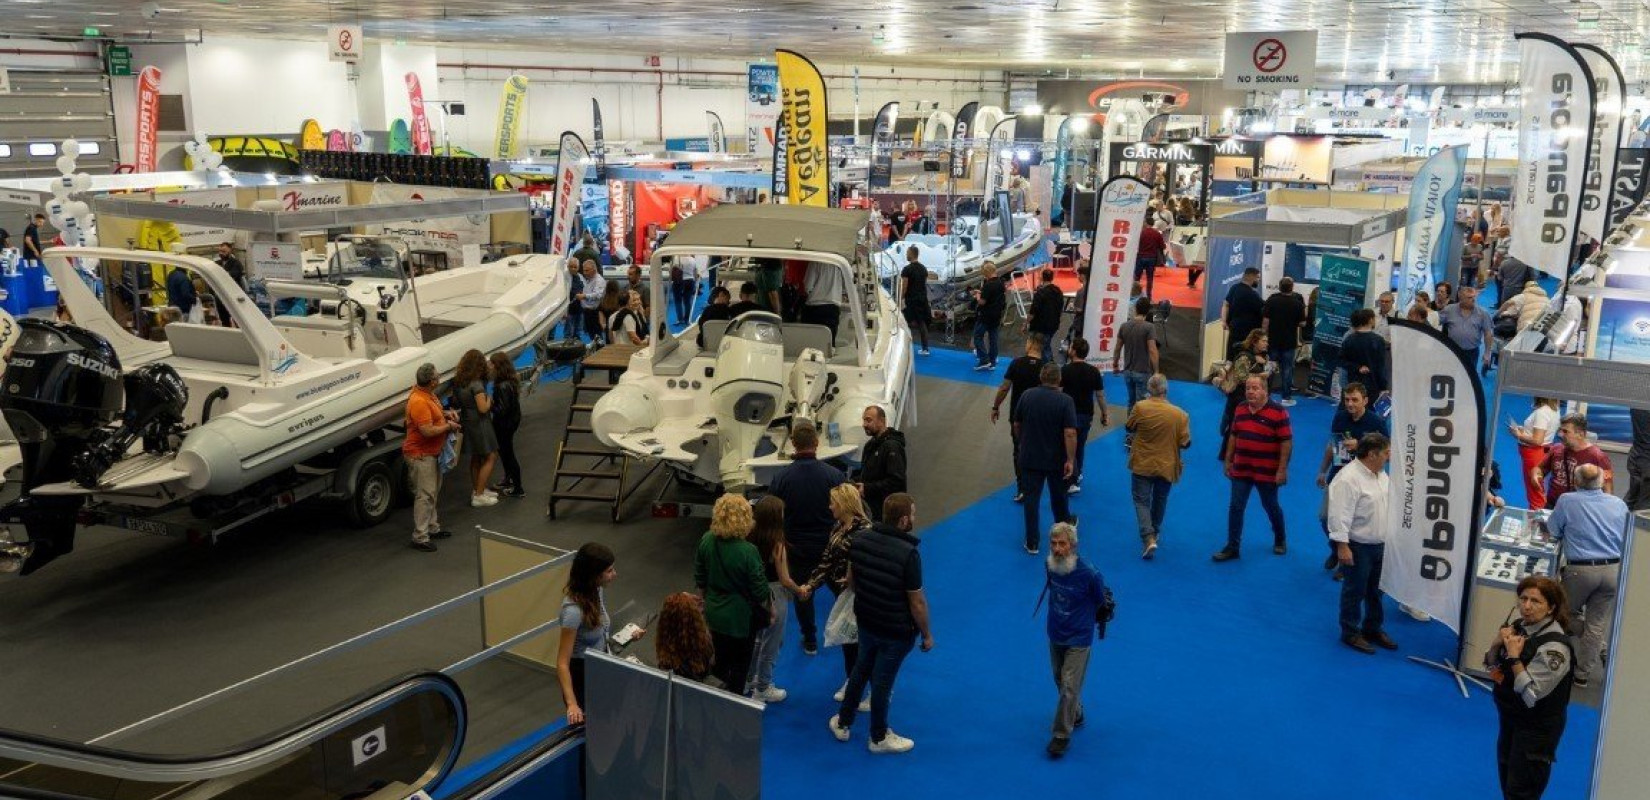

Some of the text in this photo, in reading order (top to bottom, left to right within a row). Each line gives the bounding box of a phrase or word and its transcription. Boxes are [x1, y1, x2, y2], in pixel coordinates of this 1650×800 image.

[1237, 75, 1299, 83] NO SMOKING
[775, 127, 787, 193] SIMRAD
[612, 180, 624, 249] SIMRAD
[1108, 219, 1131, 277] Rent
[1100, 297, 1119, 352] Boat
[66, 352, 118, 380] SUZUKI
